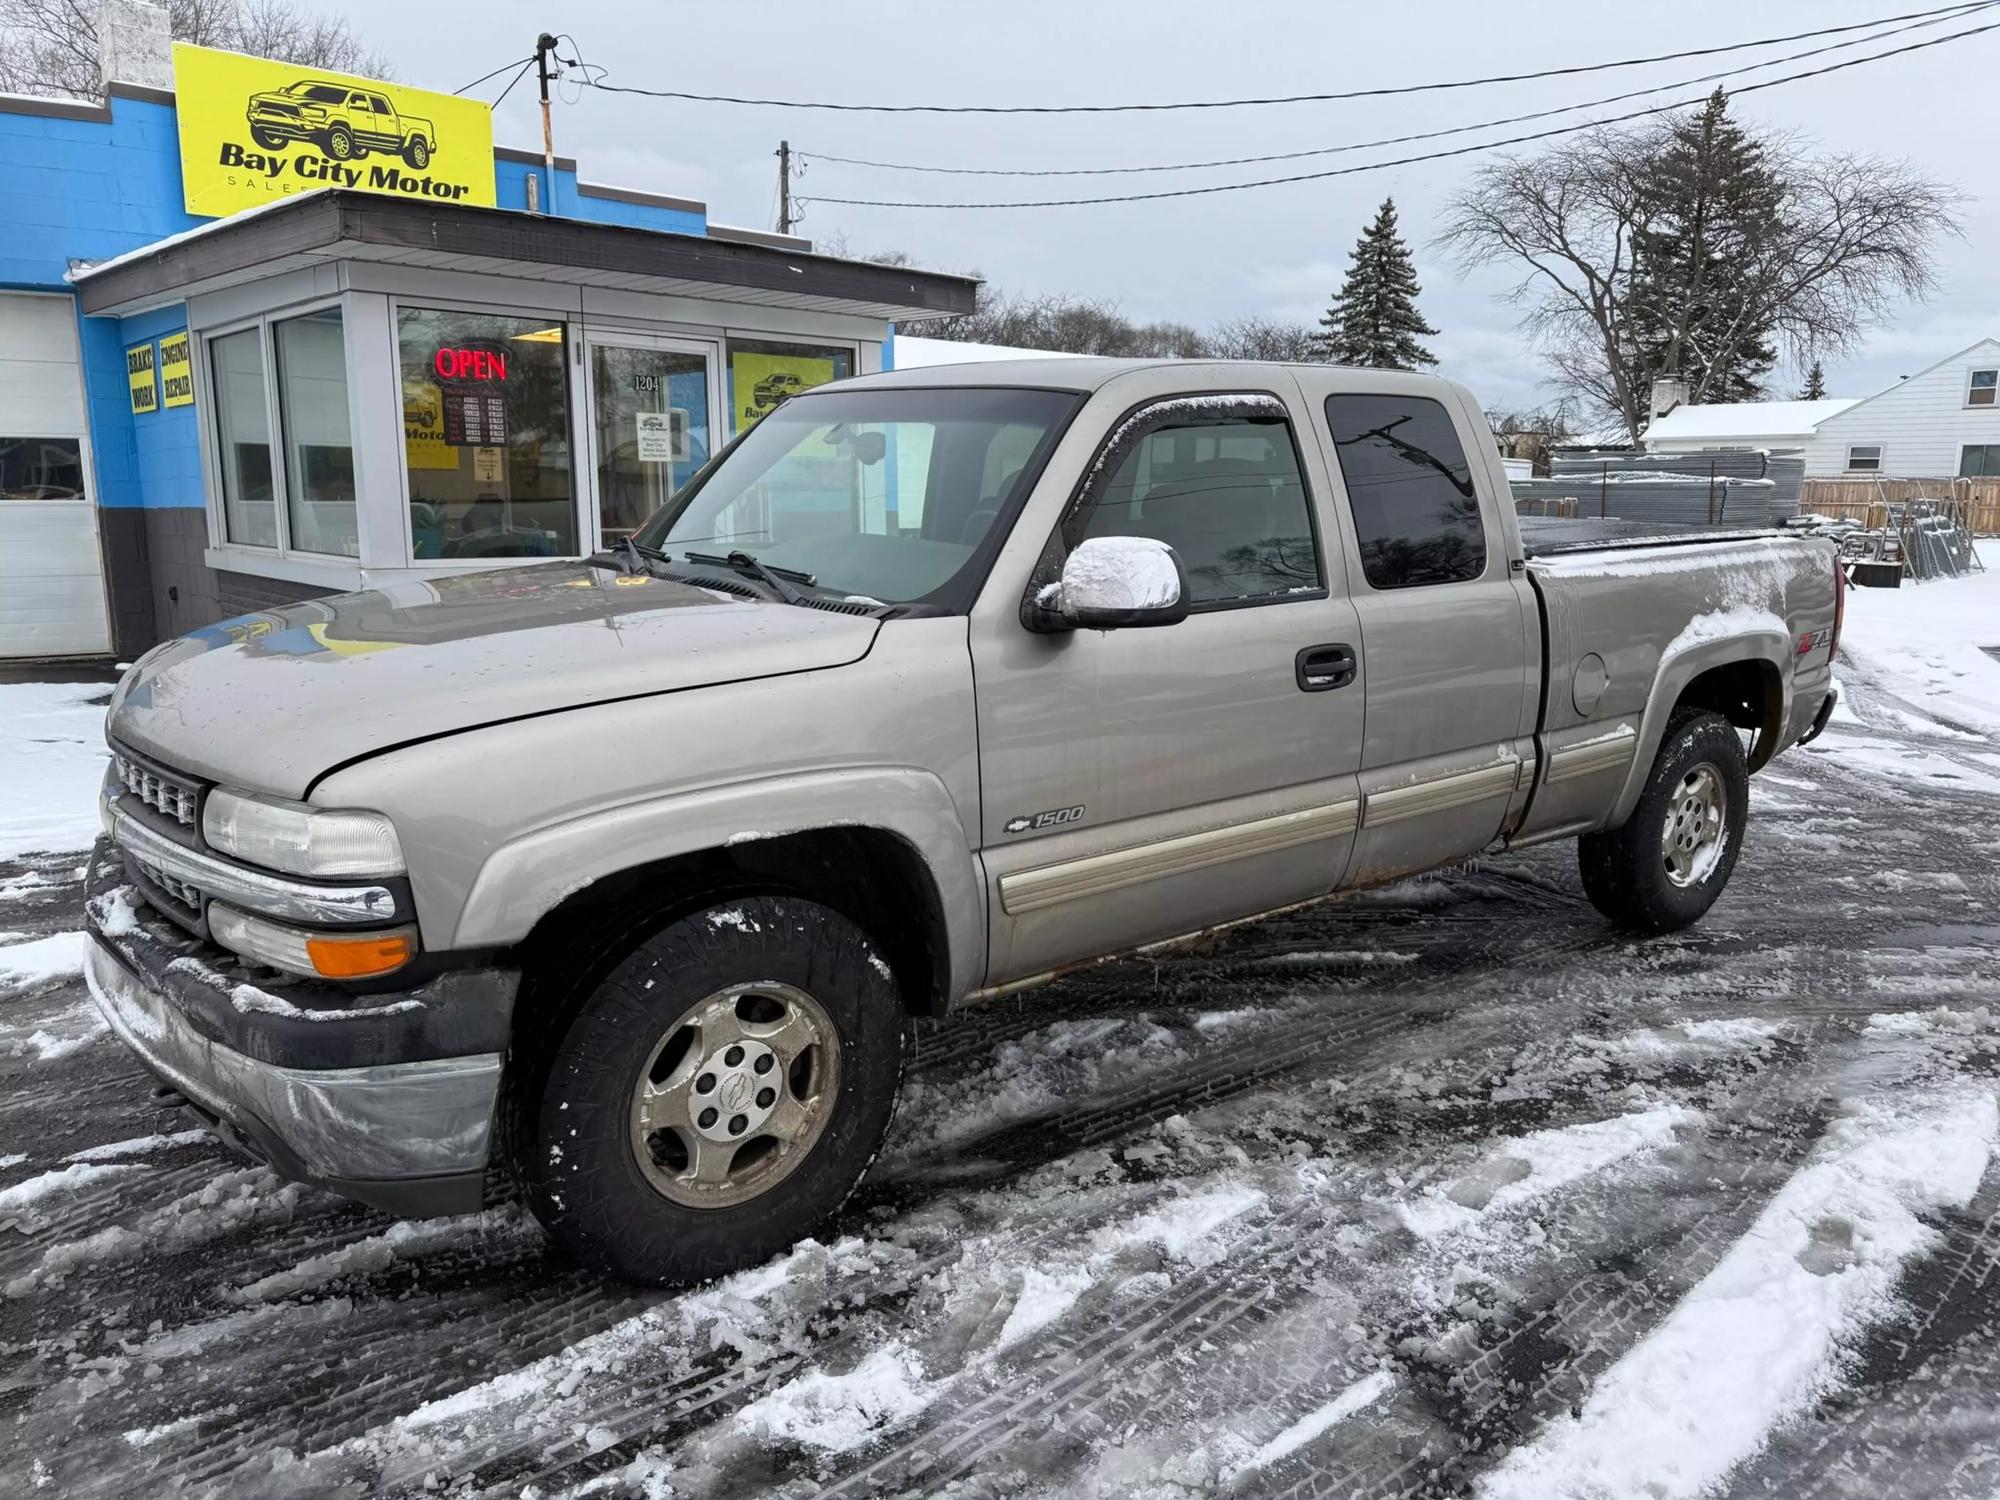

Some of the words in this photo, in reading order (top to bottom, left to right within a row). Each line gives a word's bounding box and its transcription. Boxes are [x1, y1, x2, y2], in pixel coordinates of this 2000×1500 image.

[219, 142, 288, 178] Bay
[294, 154, 363, 189] City
[368, 166, 469, 200] Motor
[128, 346, 153, 375] BRAKE
[161, 340, 188, 367] ENGINE
[435, 348, 507, 381] OPEN
[164, 375, 191, 399] REPAIR
[635, 376, 659, 391] 1204
[132, 384, 154, 408] WORK
[405, 428, 446, 441] Moto
[1034, 804, 1085, 828] 1500
